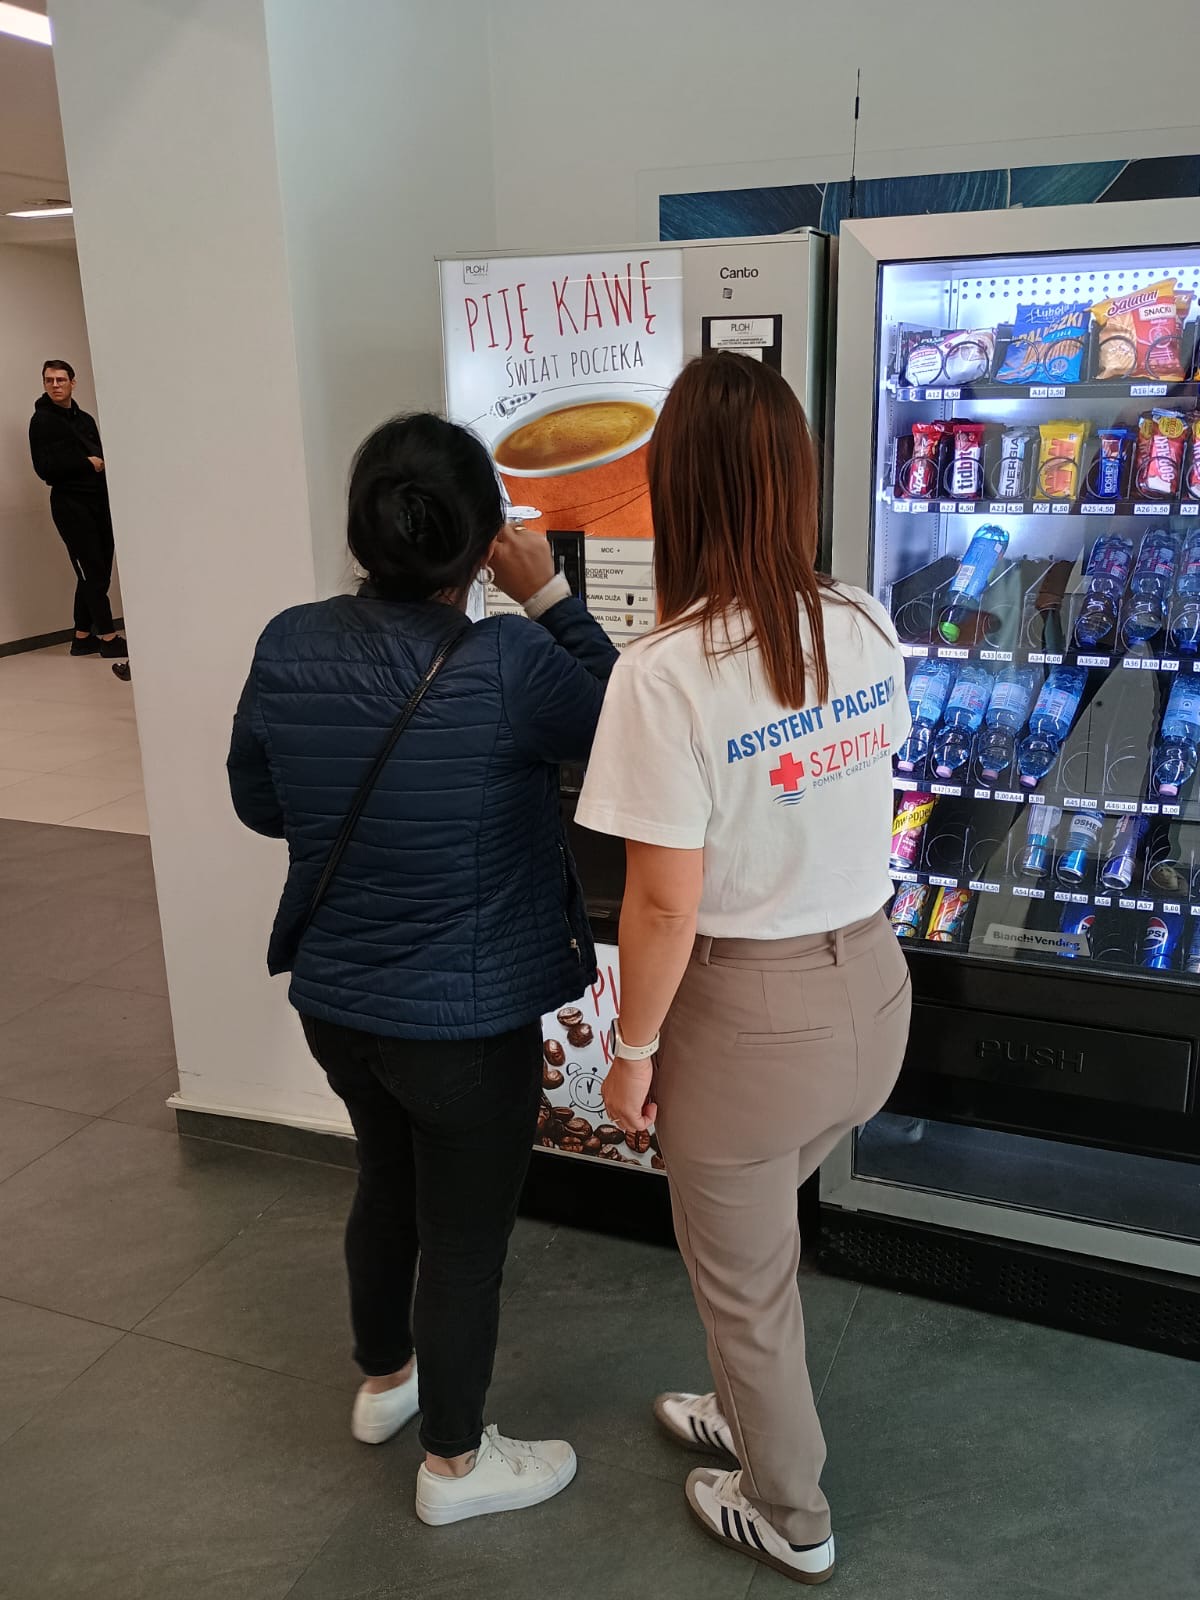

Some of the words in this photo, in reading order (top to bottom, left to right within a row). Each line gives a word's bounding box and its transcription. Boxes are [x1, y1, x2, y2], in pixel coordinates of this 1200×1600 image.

[719, 267, 759, 280] Canto
[465, 283, 534, 354] PIJĘ
[552, 260, 657, 335] KAWĘ
[506, 354, 559, 388] ŚWIAT
[570, 341, 644, 378] POCZEKA
[1005, 438, 1019, 497] ENERGIA
[586, 567, 624, 575] DODATKOWY
[587, 593, 604, 601] KAWA
[605, 594, 621, 602] DUŻA
[727, 706, 824, 764] ASYSTENT
[810, 723, 891, 778] SZPITAL
[813, 771, 843, 789] POMNIK
[980, 1039, 1085, 1073] PUSH
